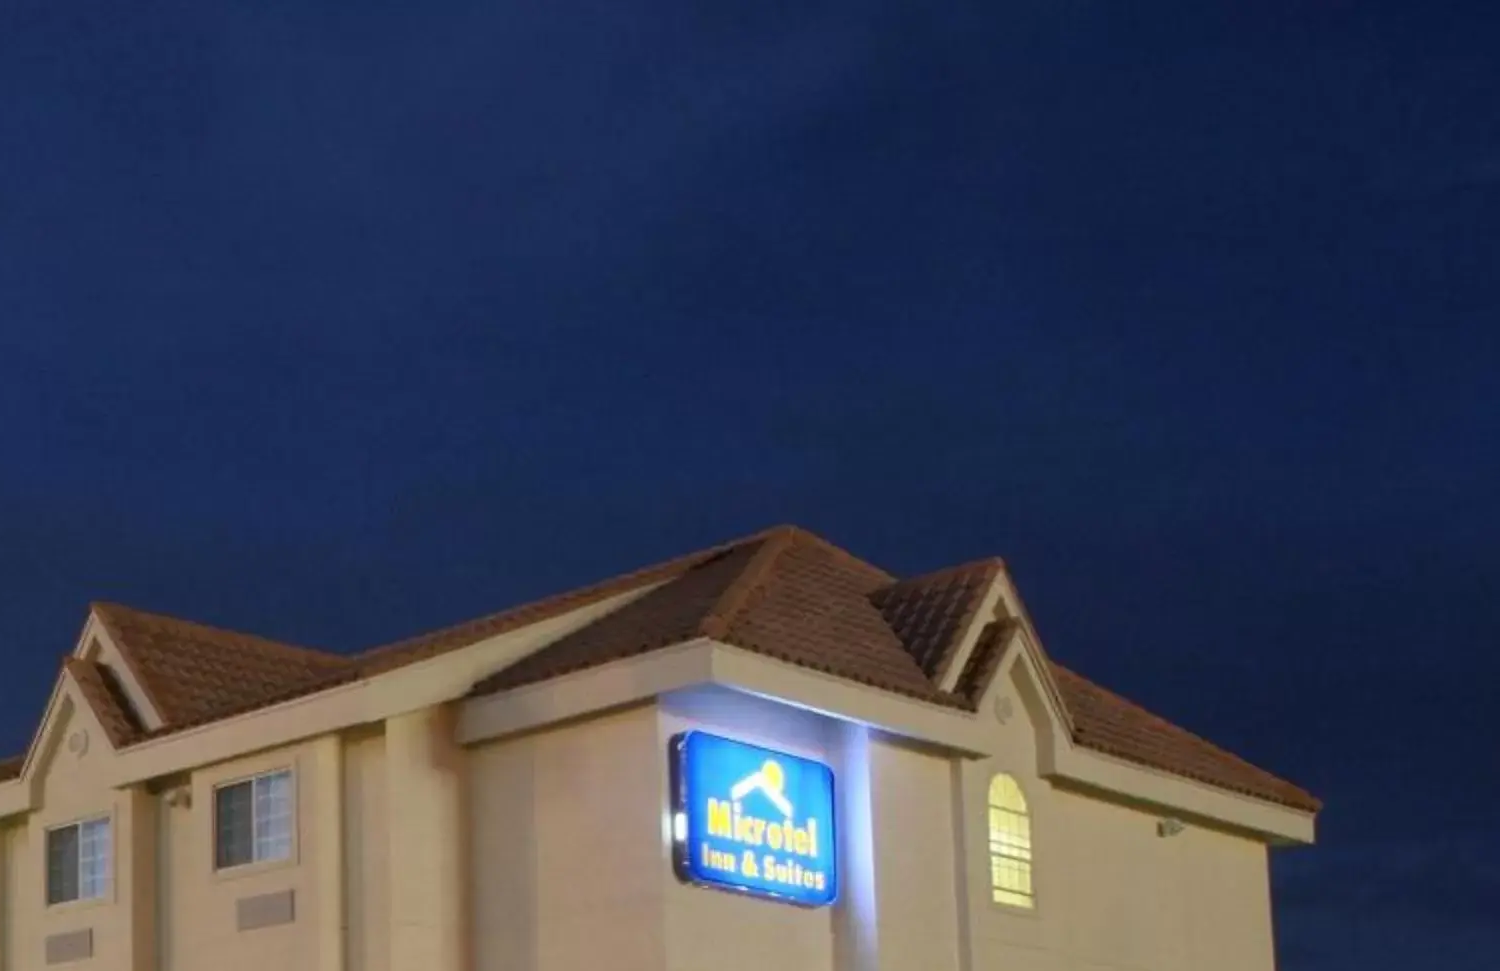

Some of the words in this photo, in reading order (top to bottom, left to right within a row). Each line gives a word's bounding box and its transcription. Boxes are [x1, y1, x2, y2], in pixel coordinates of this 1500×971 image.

[708, 799, 817, 856] Microtel
[703, 843, 735, 871] Inn
[742, 852, 760, 877] &
[764, 857, 825, 890] Suites
